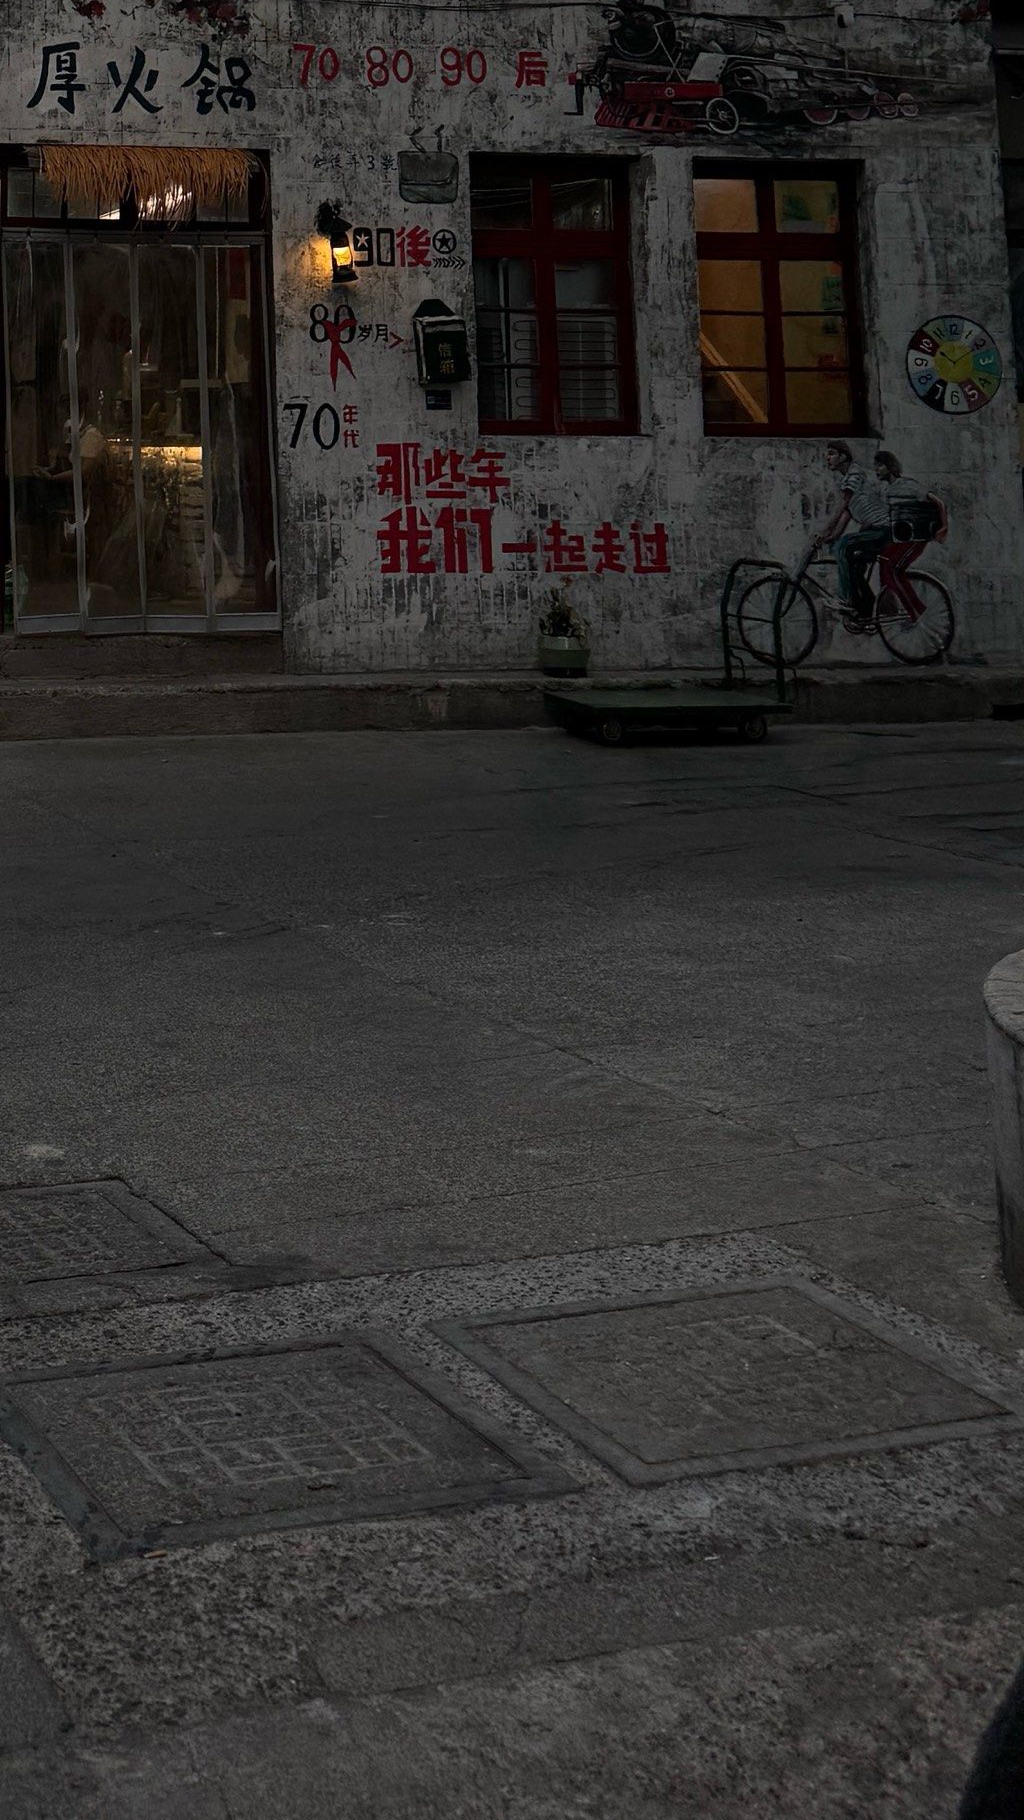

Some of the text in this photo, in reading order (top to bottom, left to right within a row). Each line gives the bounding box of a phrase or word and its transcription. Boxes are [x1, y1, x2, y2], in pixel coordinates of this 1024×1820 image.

[27, 41, 256, 115] 厚火锅
[293, 43, 548, 88] 70 80 90 后
[376, 442, 510, 505] 那些年
[376, 507, 671, 574] 我们一起走过
